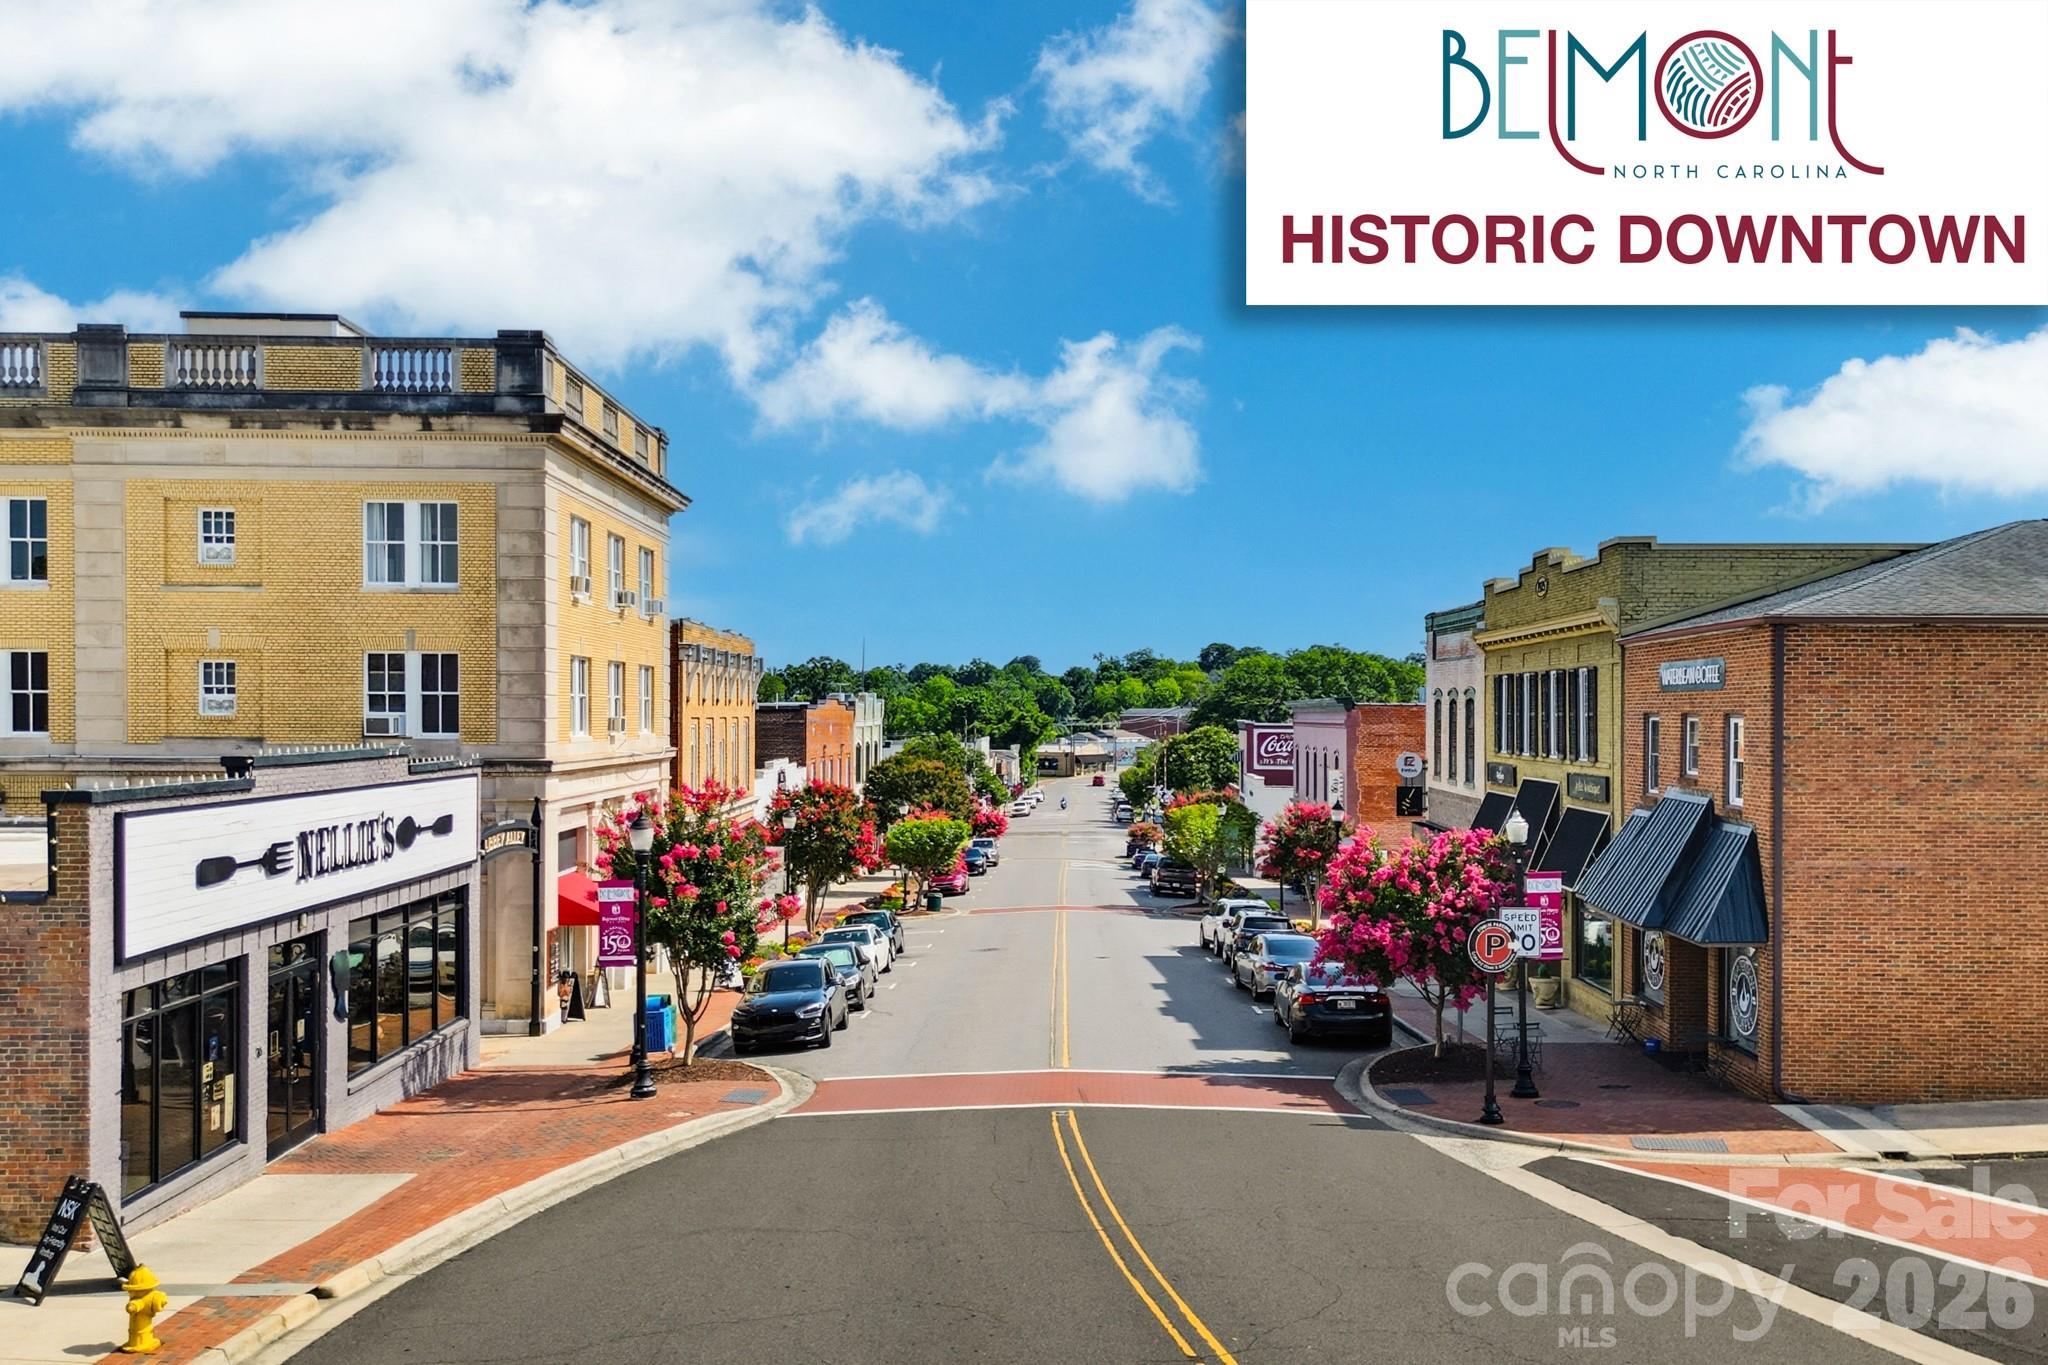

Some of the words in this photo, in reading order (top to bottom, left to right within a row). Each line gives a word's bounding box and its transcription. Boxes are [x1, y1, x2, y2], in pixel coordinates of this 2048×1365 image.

[1696, 664, 1720, 684] COFFEE
[296, 810, 396, 884] NELLIE'S
[1504, 913, 1537, 922] SPEED
[601, 935, 631, 955] 150
[1485, 933, 1506, 957] P
[57, 1198, 81, 1220] NSK
